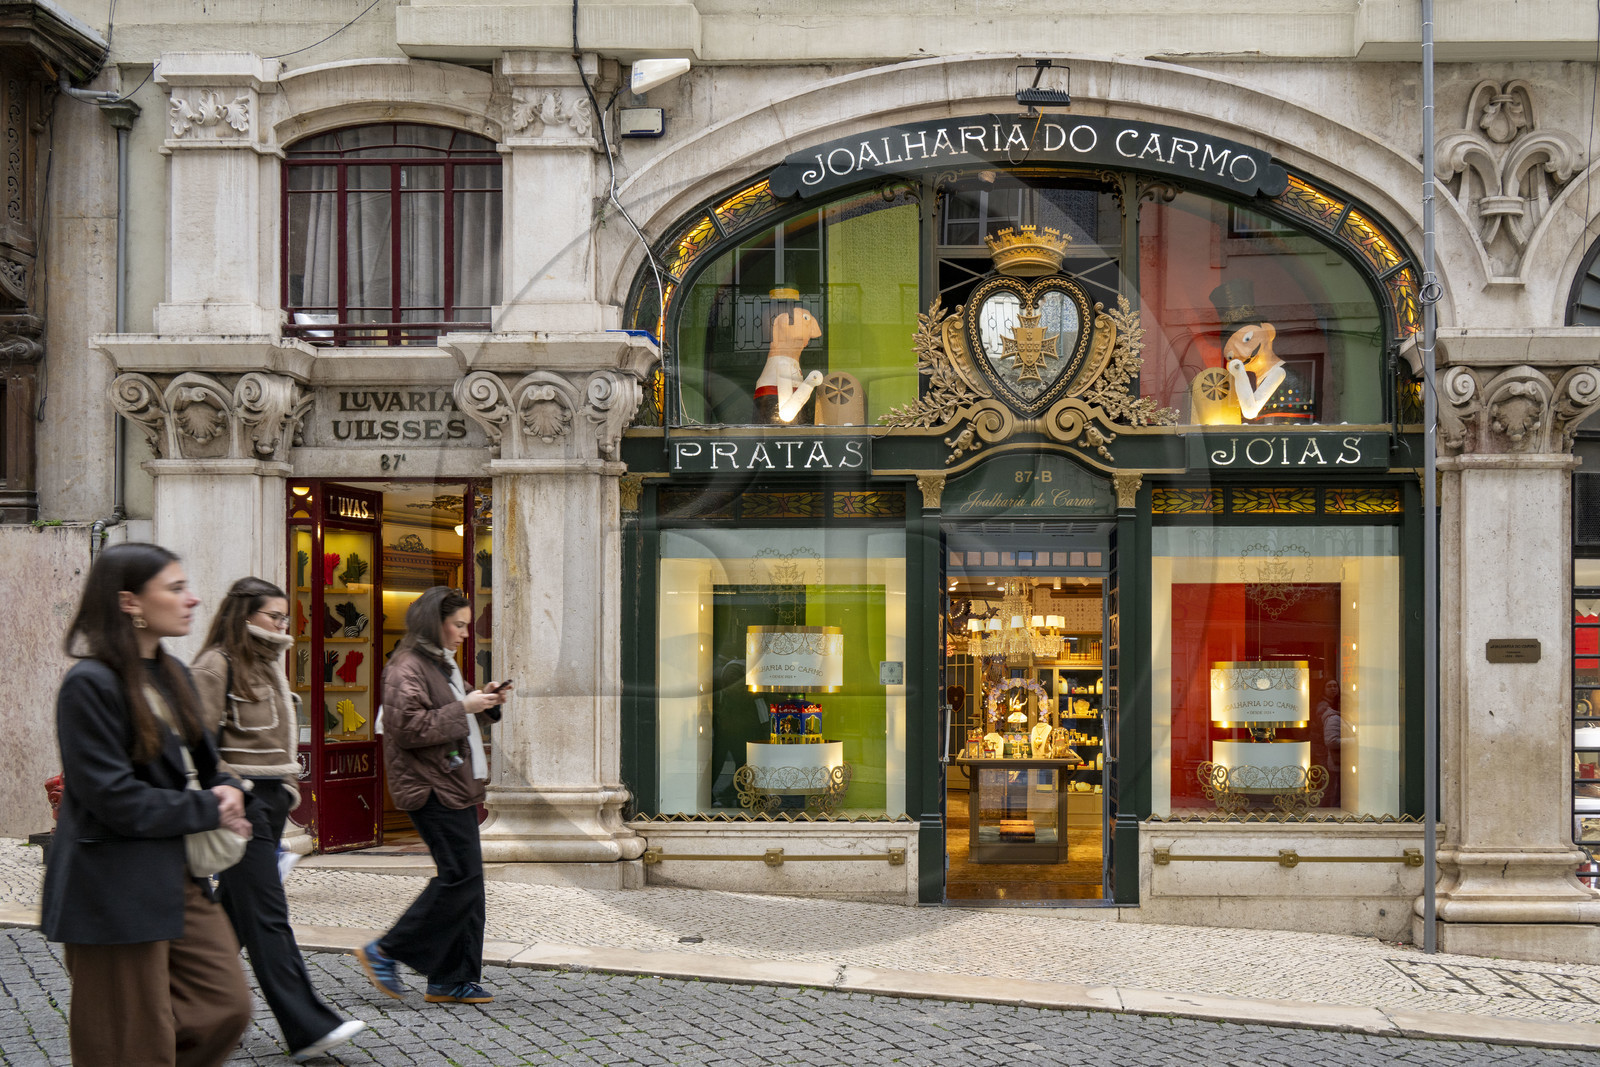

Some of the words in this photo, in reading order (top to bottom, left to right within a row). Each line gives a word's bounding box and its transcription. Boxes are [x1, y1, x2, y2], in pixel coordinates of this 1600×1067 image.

[802, 123, 1029, 186] JOALHARIA
[1043, 123, 1097, 153] DO
[1115, 129, 1257, 183] CARMO
[339, 391, 460, 412] LUVARIA
[332, 419, 467, 440] ULISSES
[674, 441, 863, 469] PRATAS
[1211, 437, 1361, 465] JÓIAS
[1014, 470, 1053, 483] 87-B
[329, 495, 369, 519] LUVAS
[960, 488, 1027, 513] Joalharia
[1030, 492, 1045, 507] do
[1051, 488, 1096, 507] Carmo
[784, 664, 795, 672] DO
[797, 665, 824, 677] CARMO
[1276, 701, 1299, 713] CARMO
[329, 753, 369, 775] LUVAS
